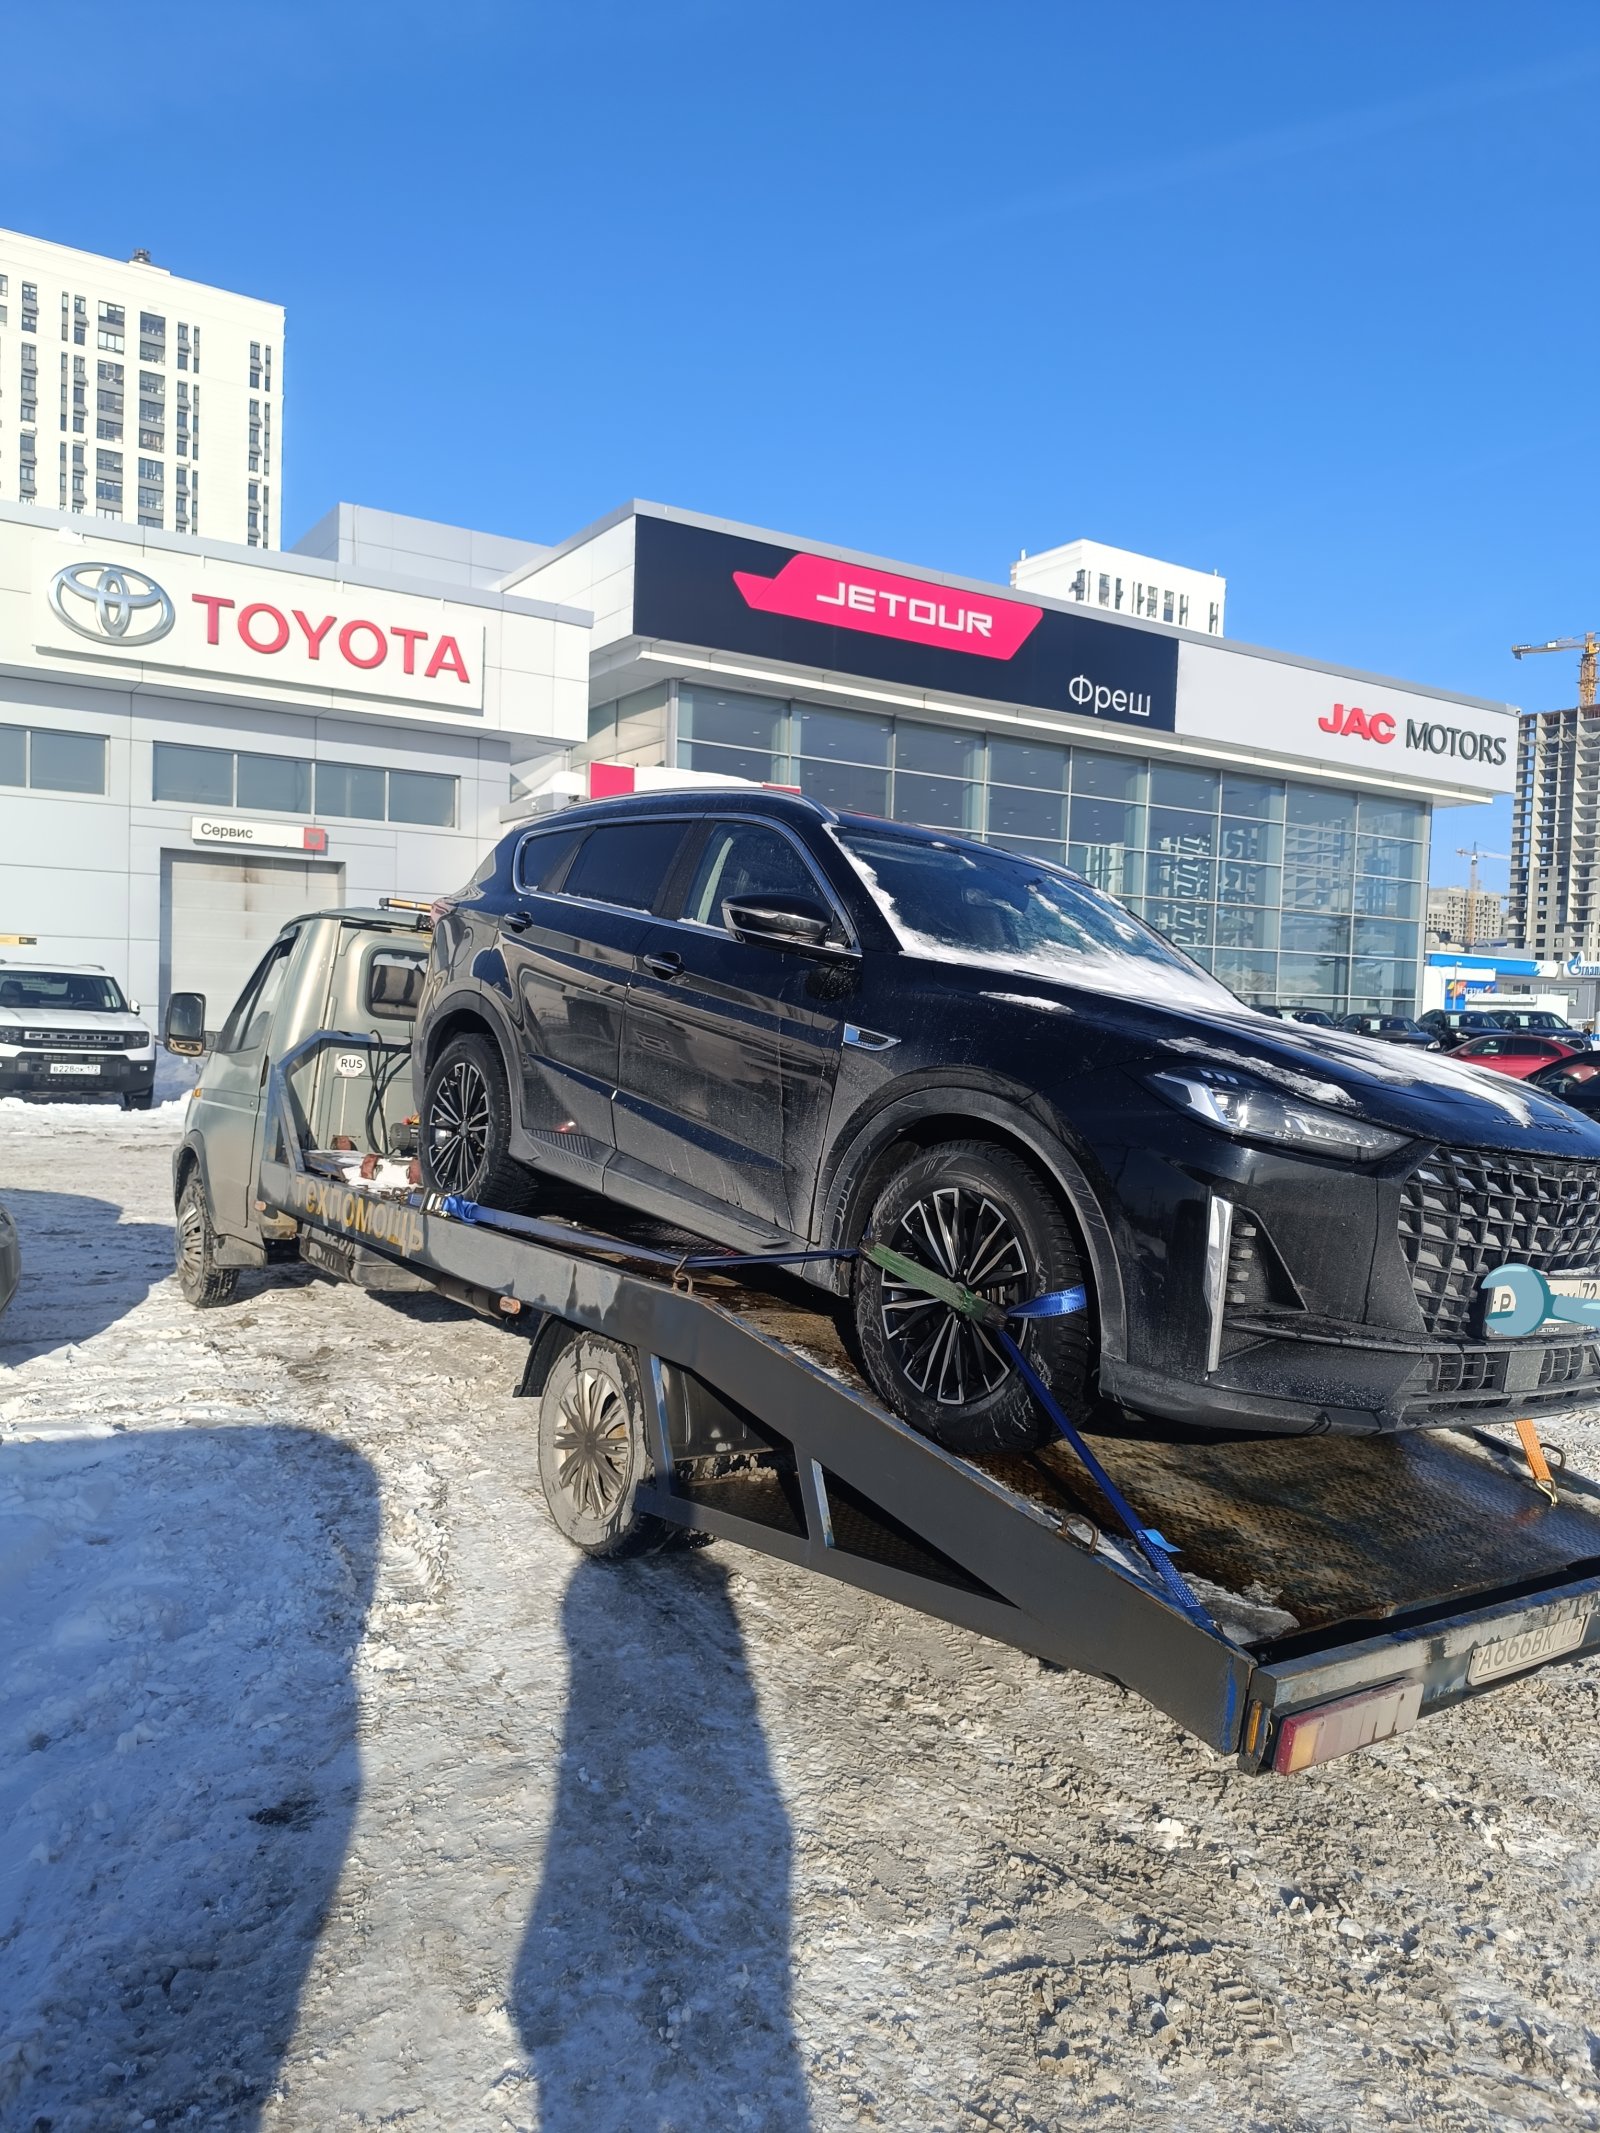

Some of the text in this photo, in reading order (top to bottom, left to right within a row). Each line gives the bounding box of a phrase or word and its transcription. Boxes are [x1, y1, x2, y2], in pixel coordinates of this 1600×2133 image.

[816, 582, 992, 638] JETOUR
[191, 593, 471, 684] TOYOTA
[1069, 675, 1151, 716] Фреш
[1318, 703, 1506, 765] JAC MOTORS
[200, 822, 254, 839] Сервис
[341, 1058, 363, 1069] RUS
